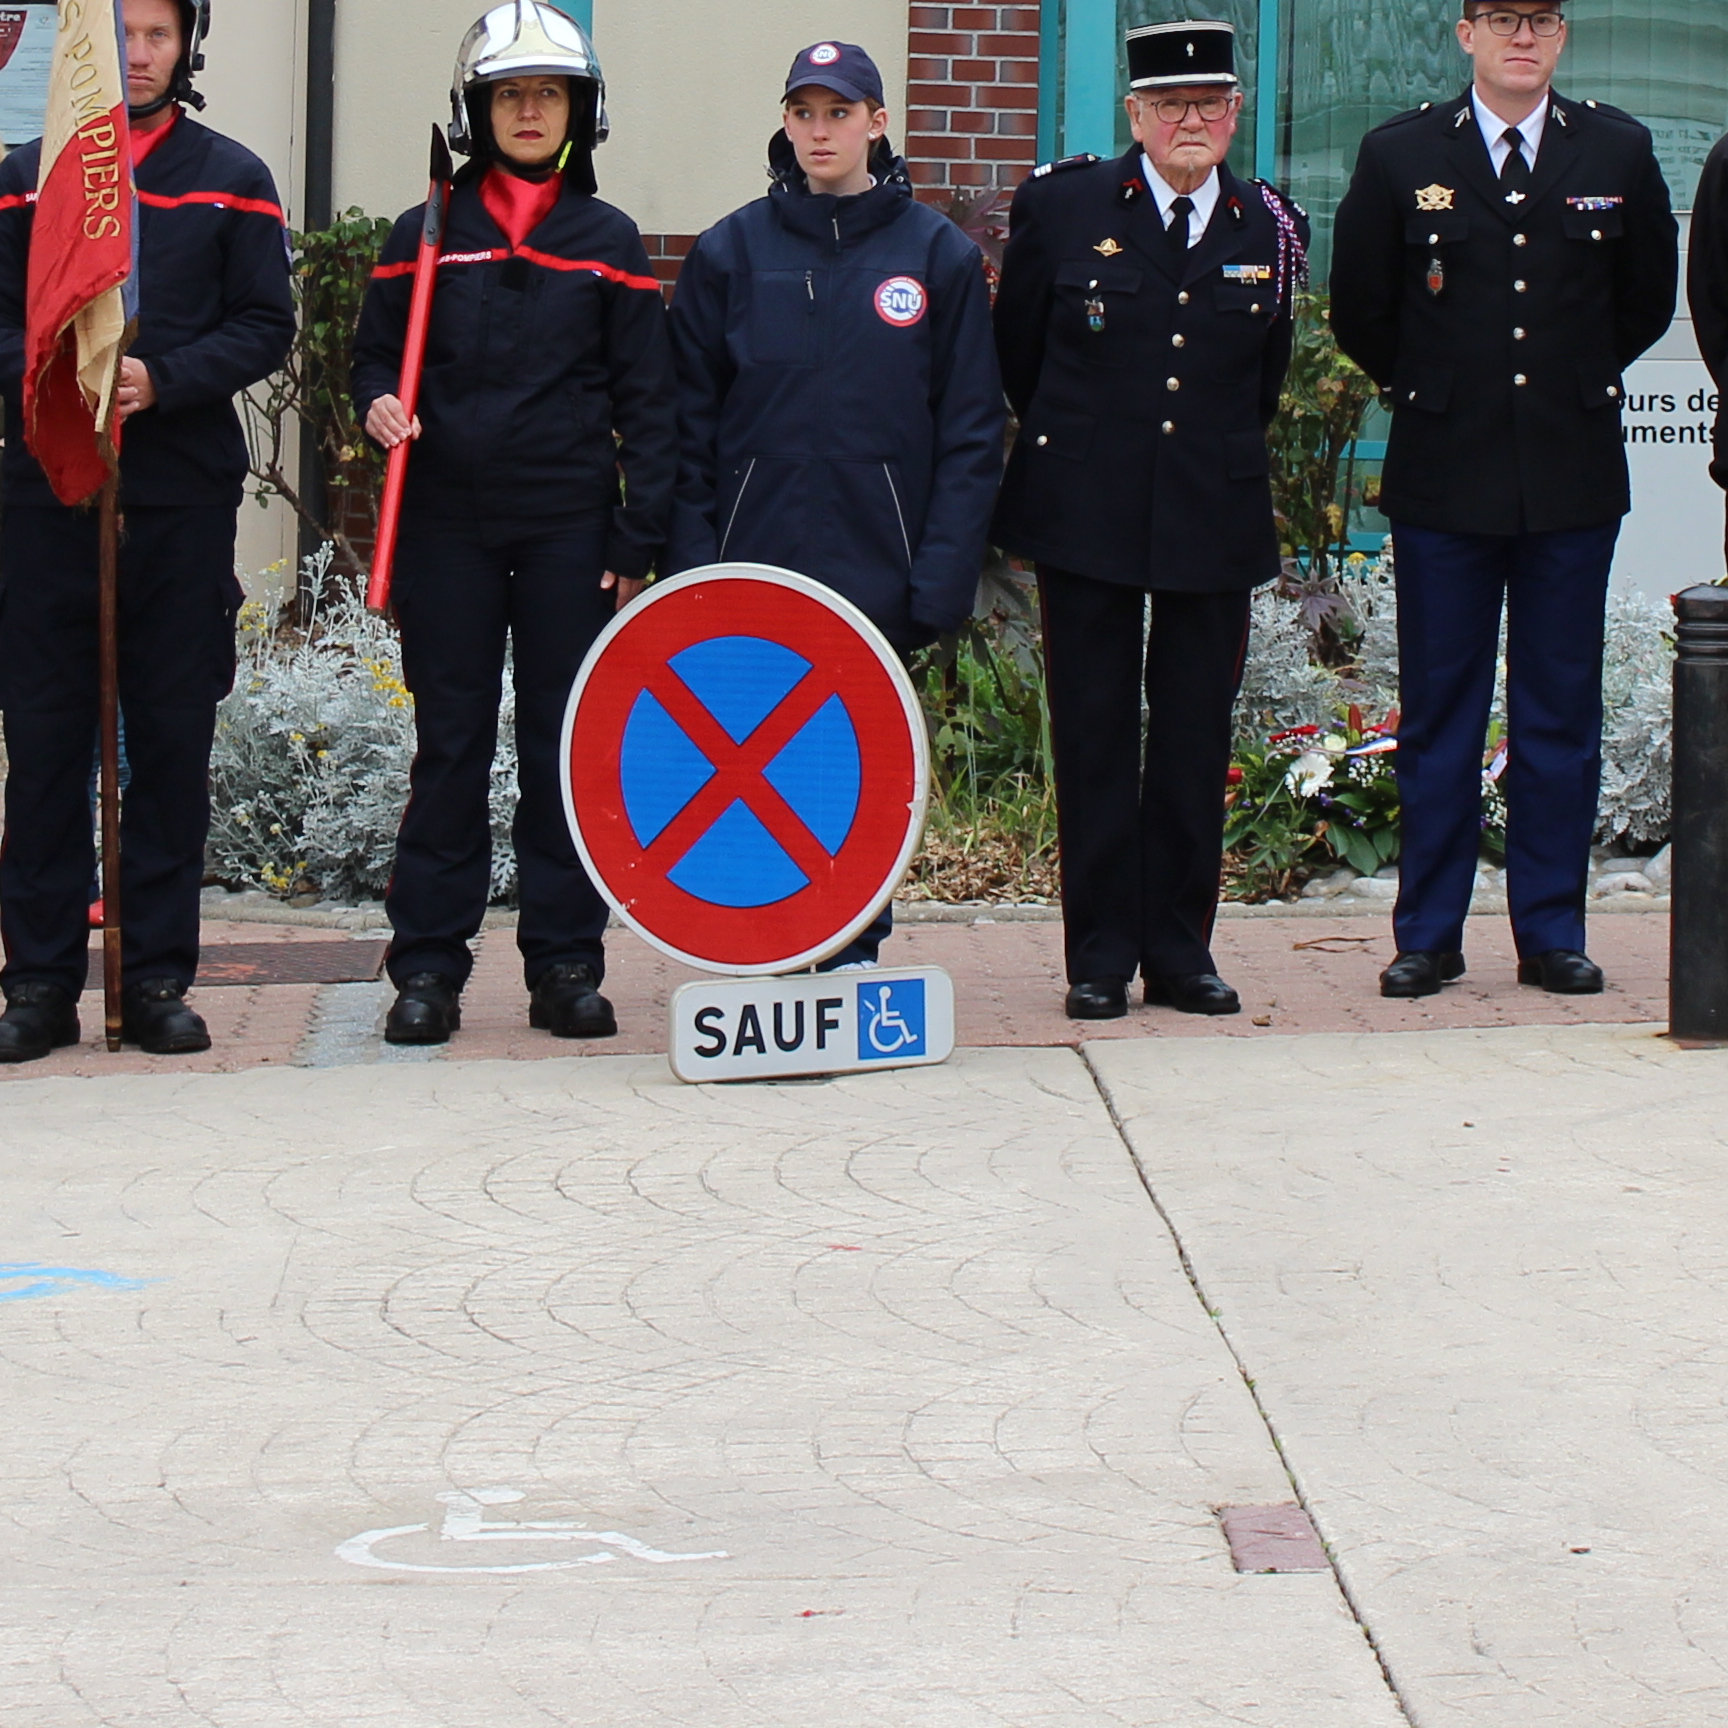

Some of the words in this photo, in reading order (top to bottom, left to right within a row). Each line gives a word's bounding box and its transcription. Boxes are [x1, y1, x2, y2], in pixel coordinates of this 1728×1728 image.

[64, 33, 121, 240] POMPIERS
[880, 292, 922, 311] SNU
[1622, 393, 1676, 413] urs
[693, 997, 844, 1059] SAUF
